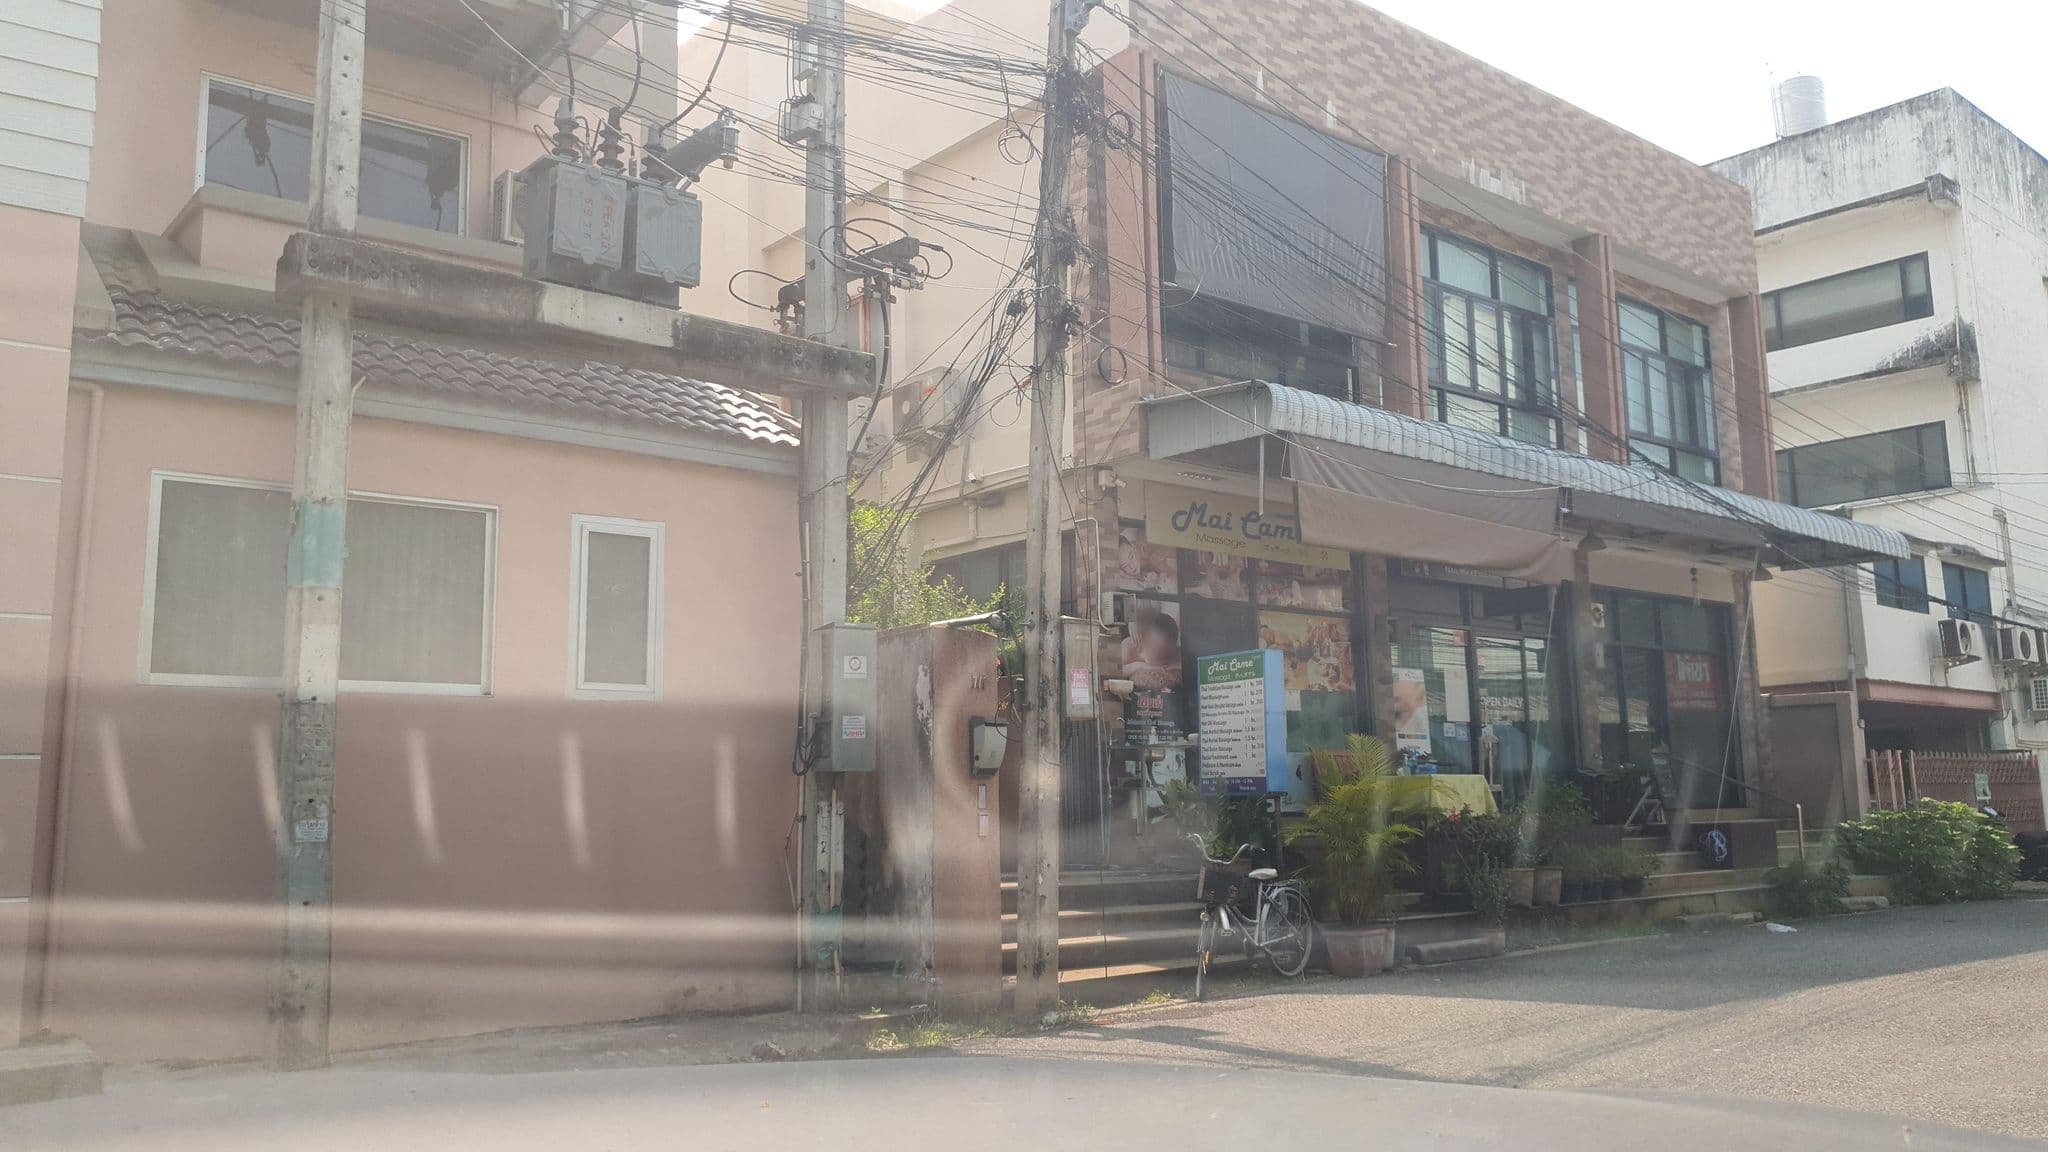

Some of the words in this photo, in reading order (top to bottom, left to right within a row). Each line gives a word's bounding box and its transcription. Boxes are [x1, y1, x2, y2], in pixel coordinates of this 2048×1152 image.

[1171, 501, 1233, 532] Mai
[1240, 510, 1297, 541] Cam
[1195, 533, 1247, 549] Massage
[1207, 660, 1228, 675] Mai
[1229, 658, 1254, 671] Came
